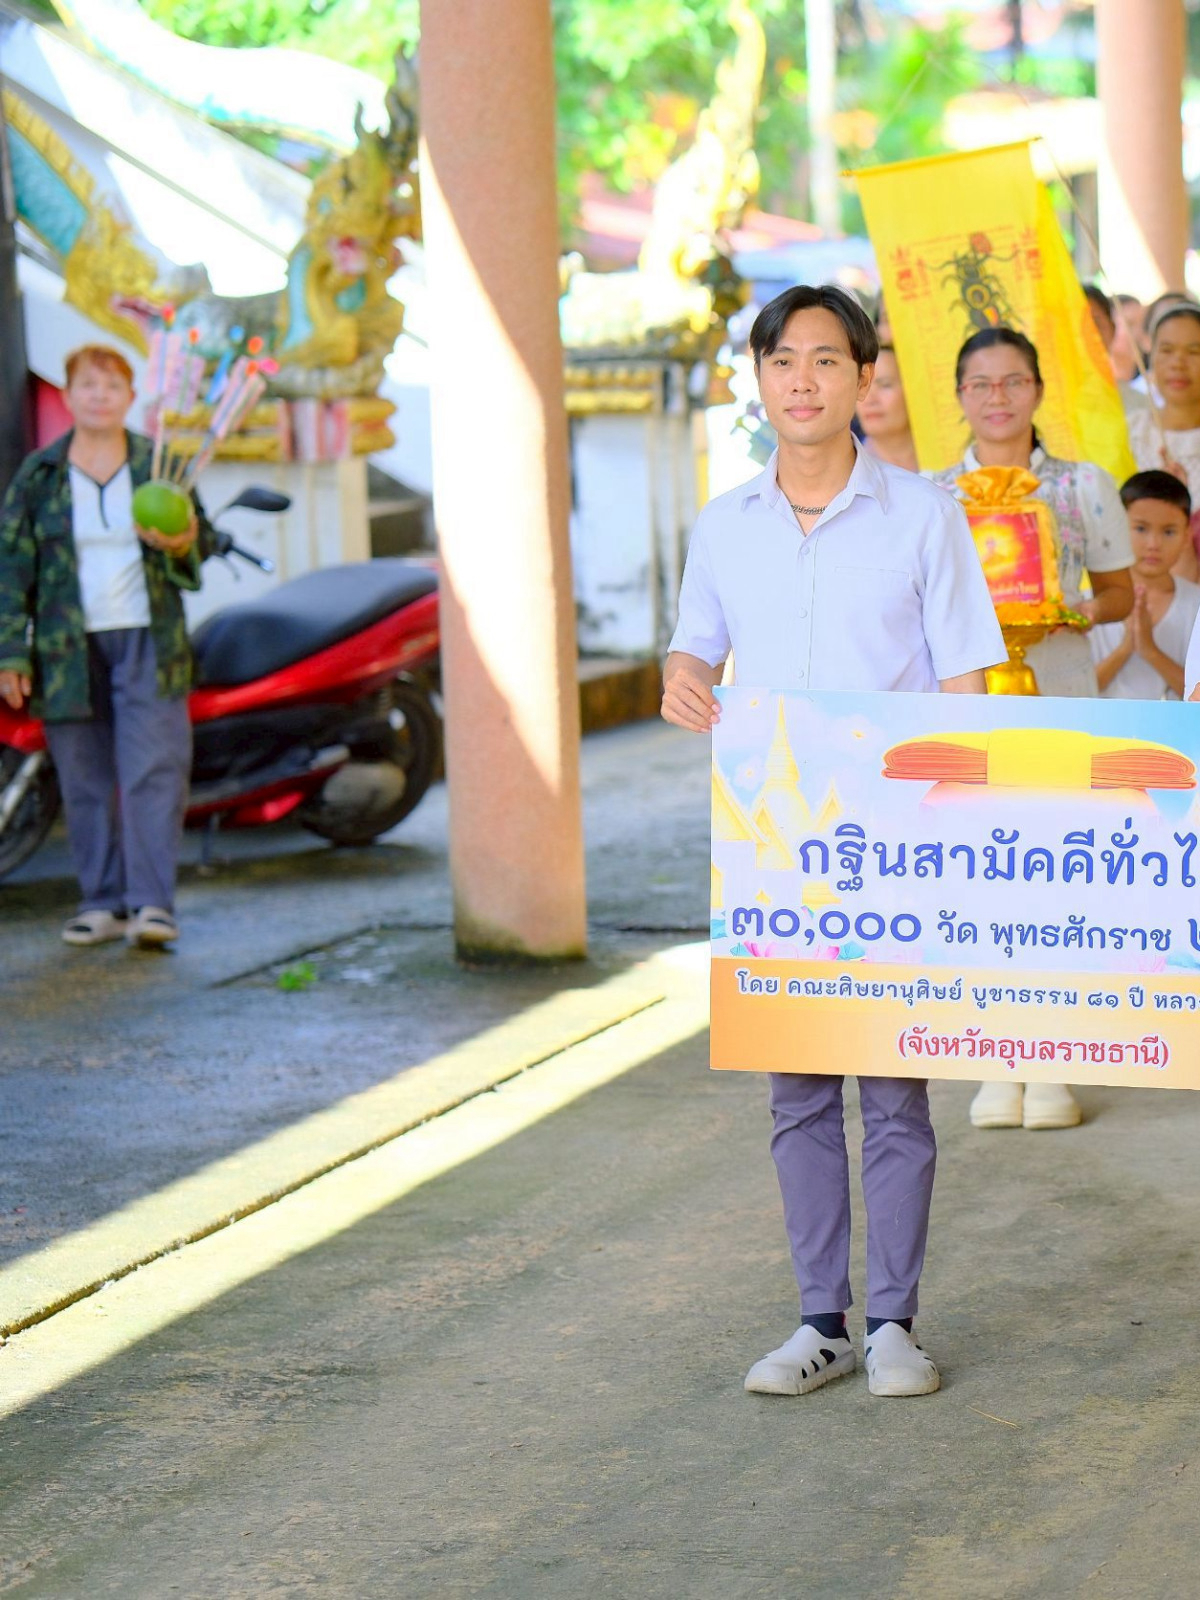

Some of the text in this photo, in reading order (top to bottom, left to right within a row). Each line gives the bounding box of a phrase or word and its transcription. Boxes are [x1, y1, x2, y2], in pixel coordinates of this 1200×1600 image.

[731, 906, 922, 946] ๓๐,๐๐๐
[937, 909, 978, 944] วัด
[990, 914, 1172, 958] พุทธศักราช
[737, 971, 778, 993] โดย
[788, 976, 962, 1006] คณะศิษยานุศิษย์
[972, 984, 1078, 1009] บูชาธรรม
[1087, 990, 1119, 1008] ๘๑
[1129, 986, 1144, 1008] ปี
[899, 1026, 1169, 1069] (จังหวัดอุบลราชธานี)
